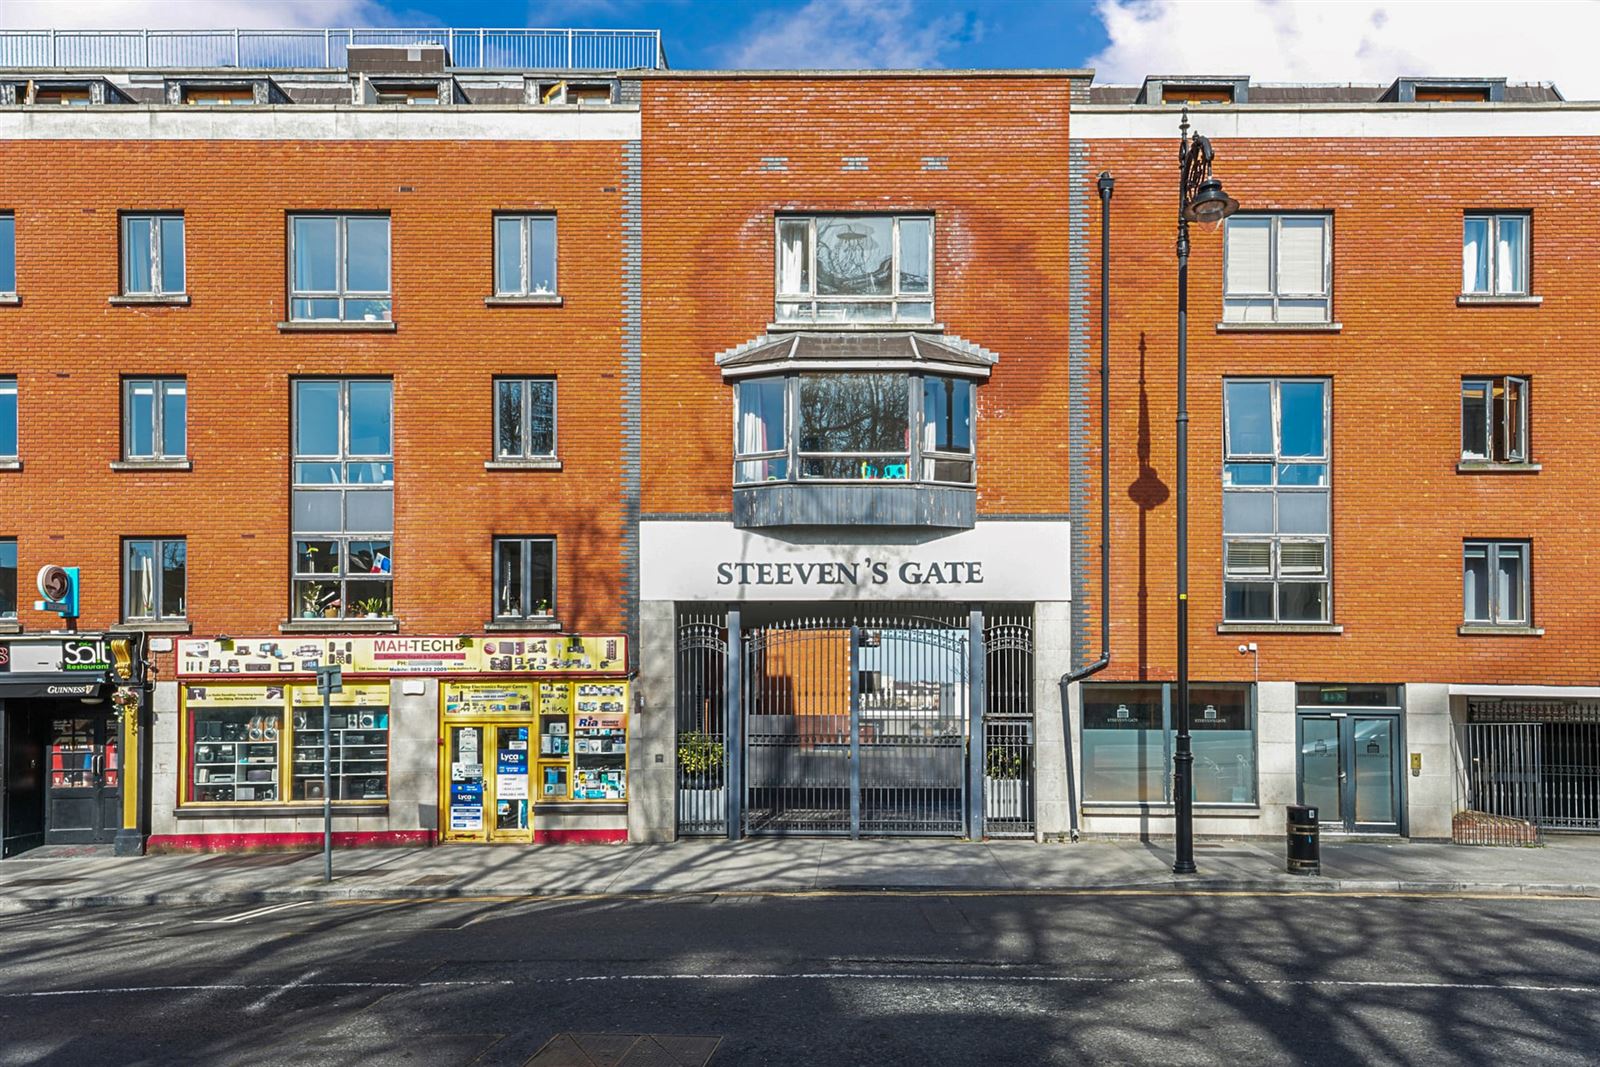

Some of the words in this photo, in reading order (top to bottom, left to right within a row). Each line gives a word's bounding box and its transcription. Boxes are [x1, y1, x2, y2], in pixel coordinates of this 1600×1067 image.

[717, 557, 889, 585] STEEVEN'S
[899, 562, 985, 584] GATE
[374, 640, 454, 652] MAH-TECH
[65, 641, 111, 664] Salt
[47, 685, 86, 694] GUINNESS
[578, 716, 599, 727] Ria
[501, 753, 519, 761] Lyca
